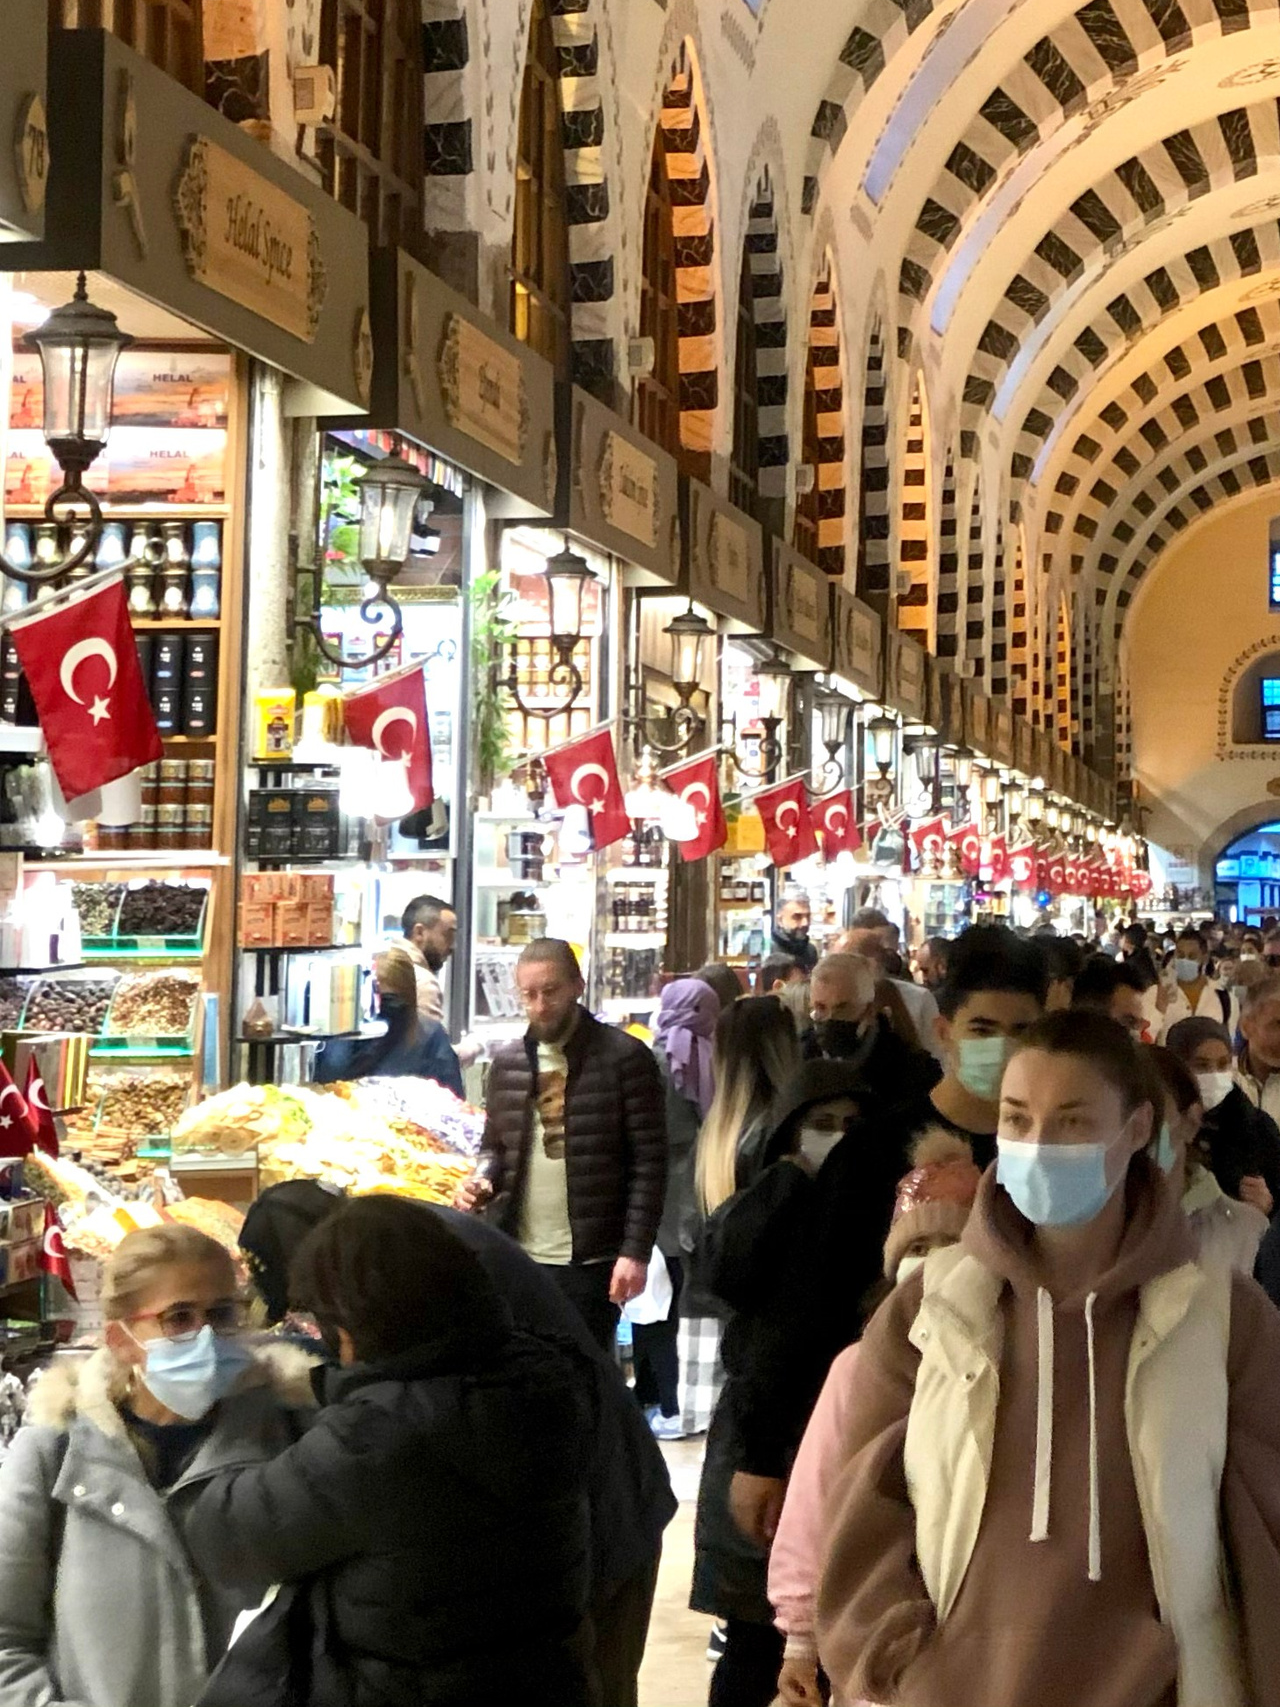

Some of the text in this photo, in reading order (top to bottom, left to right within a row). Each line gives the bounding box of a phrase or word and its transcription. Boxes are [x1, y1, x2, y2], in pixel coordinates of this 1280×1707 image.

[224, 196, 294, 285] Helal Spice
[152, 373, 193, 383] HELAL
[150, 449, 189, 459] HELAL
